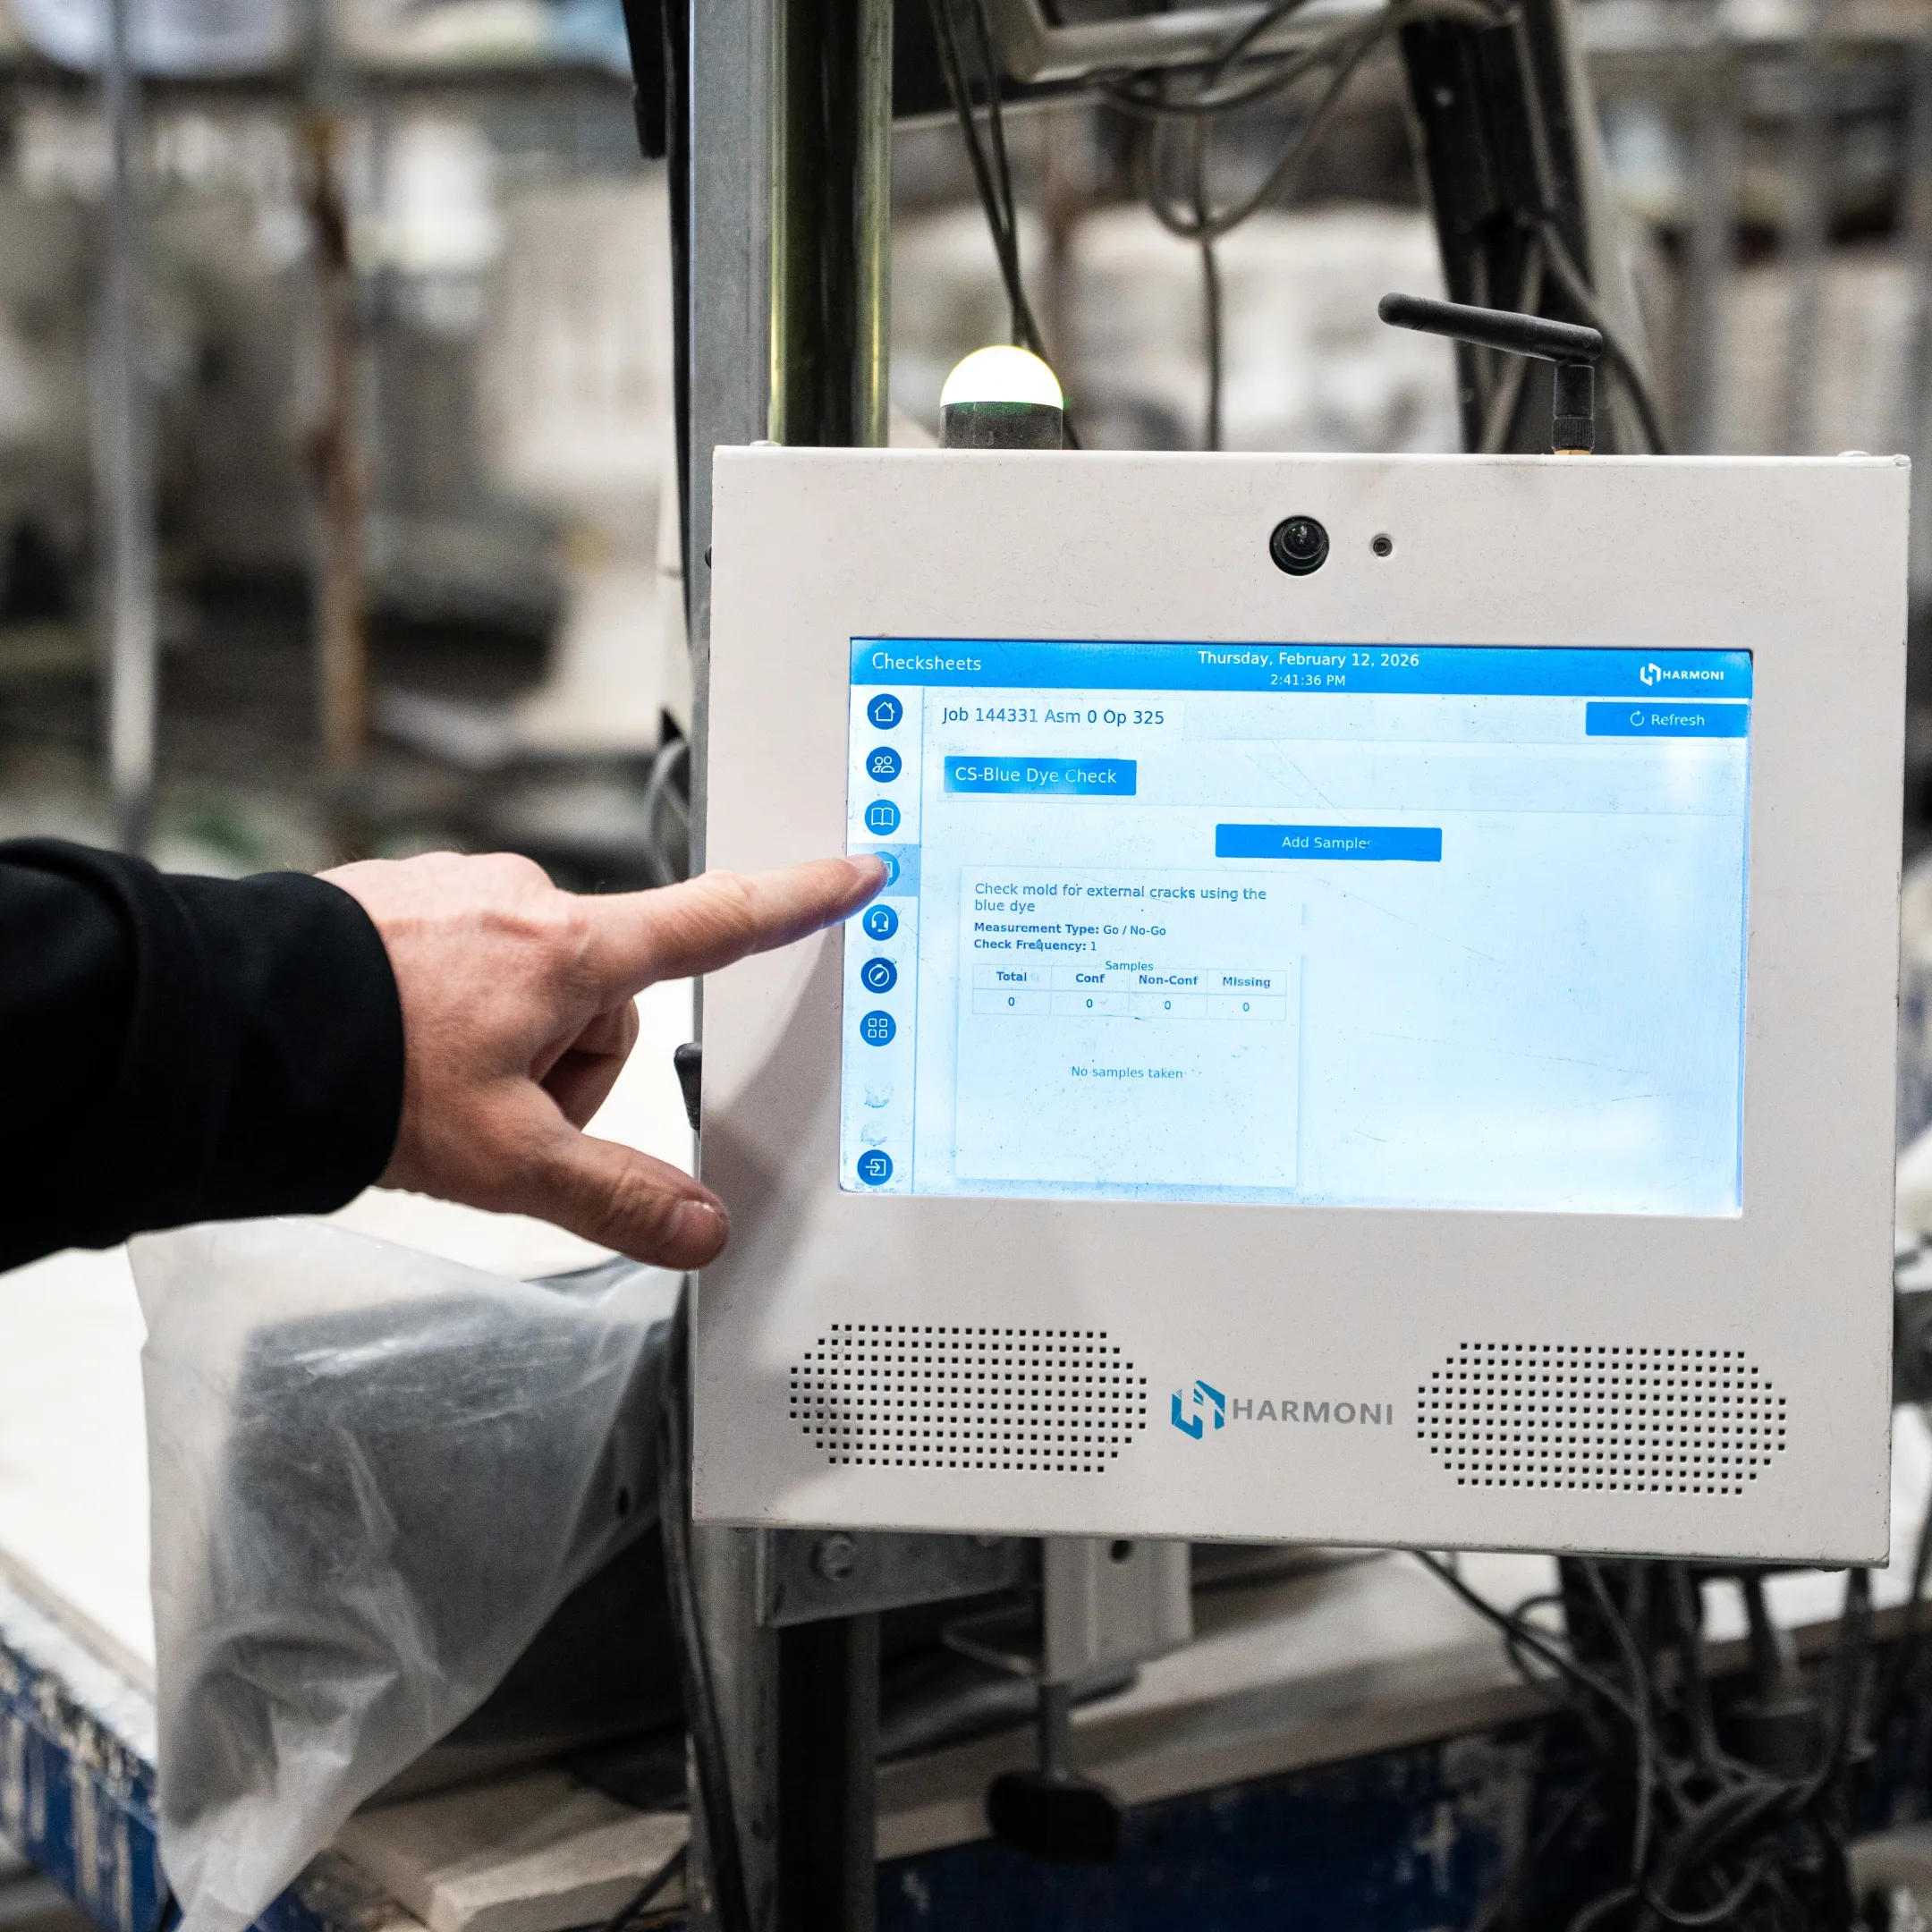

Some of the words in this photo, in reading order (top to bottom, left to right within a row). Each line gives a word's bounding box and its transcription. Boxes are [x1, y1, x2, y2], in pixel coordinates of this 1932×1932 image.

[871, 651, 982, 671] Checksheets
[1199, 650, 1273, 667] Thursday,
[1279, 652, 1346, 668] February
[1352, 653, 1375, 667] 12,
[1380, 654, 1419, 666] 2026
[1270, 674, 1321, 685] 2:41:36
[1326, 674, 1346, 686] PM
[1662, 670, 1724, 680] HARMONI
[942, 707, 969, 724] Job
[975, 708, 1038, 723] 144331
[1045, 709, 1080, 724] Asm
[1088, 709, 1097, 724] 0
[1103, 709, 1127, 726] Op
[1133, 710, 1165, 724] 325
[1651, 714, 1705, 726] Refresh
[954, 767, 1021, 782] CS-Blue
[1027, 768, 1059, 784] Dye
[1065, 768, 1117, 784] Check
[1282, 836, 1309, 848] Add
[975, 884, 1018, 895] Check
[1022, 885, 1057, 896] mold
[1063, 885, 1082, 896] for
[1087, 886, 1144, 897] external
[1149, 886, 1196, 899] cracks
[1200, 888, 1238, 902] using
[1242, 888, 1267, 900] the
[975, 900, 1004, 911] blue
[1010, 901, 1035, 914] dye
[975, 923, 1062, 934] Measurement
[1065, 924, 1099, 937] Type:
[1103, 926, 1119, 935] Go
[1123, 926, 1127, 936] /
[1131, 926, 1166, 936] No-Go
[974, 939, 1012, 949] Check
[1016, 940, 1086, 953] Frequency:
[1090, 942, 1097, 951] 1
[1106, 961, 1153, 972] Samples
[996, 971, 1027, 981] Total
[1076, 973, 1105, 983] Conf
[1139, 975, 1199, 986] Non-Conf
[1223, 977, 1271, 988] Missing
[1008, 997, 1014, 1006] 0
[1087, 999, 1093, 1008] 0
[1165, 1000, 1171, 1010] 0
[1242, 1002, 1250, 1012] 0
[1072, 1066, 1088, 1076] No
[1092, 1067, 1144, 1080] samples
[1148, 1068, 1183, 1079] taken
[1233, 1398, 1393, 1426] HARMONI
